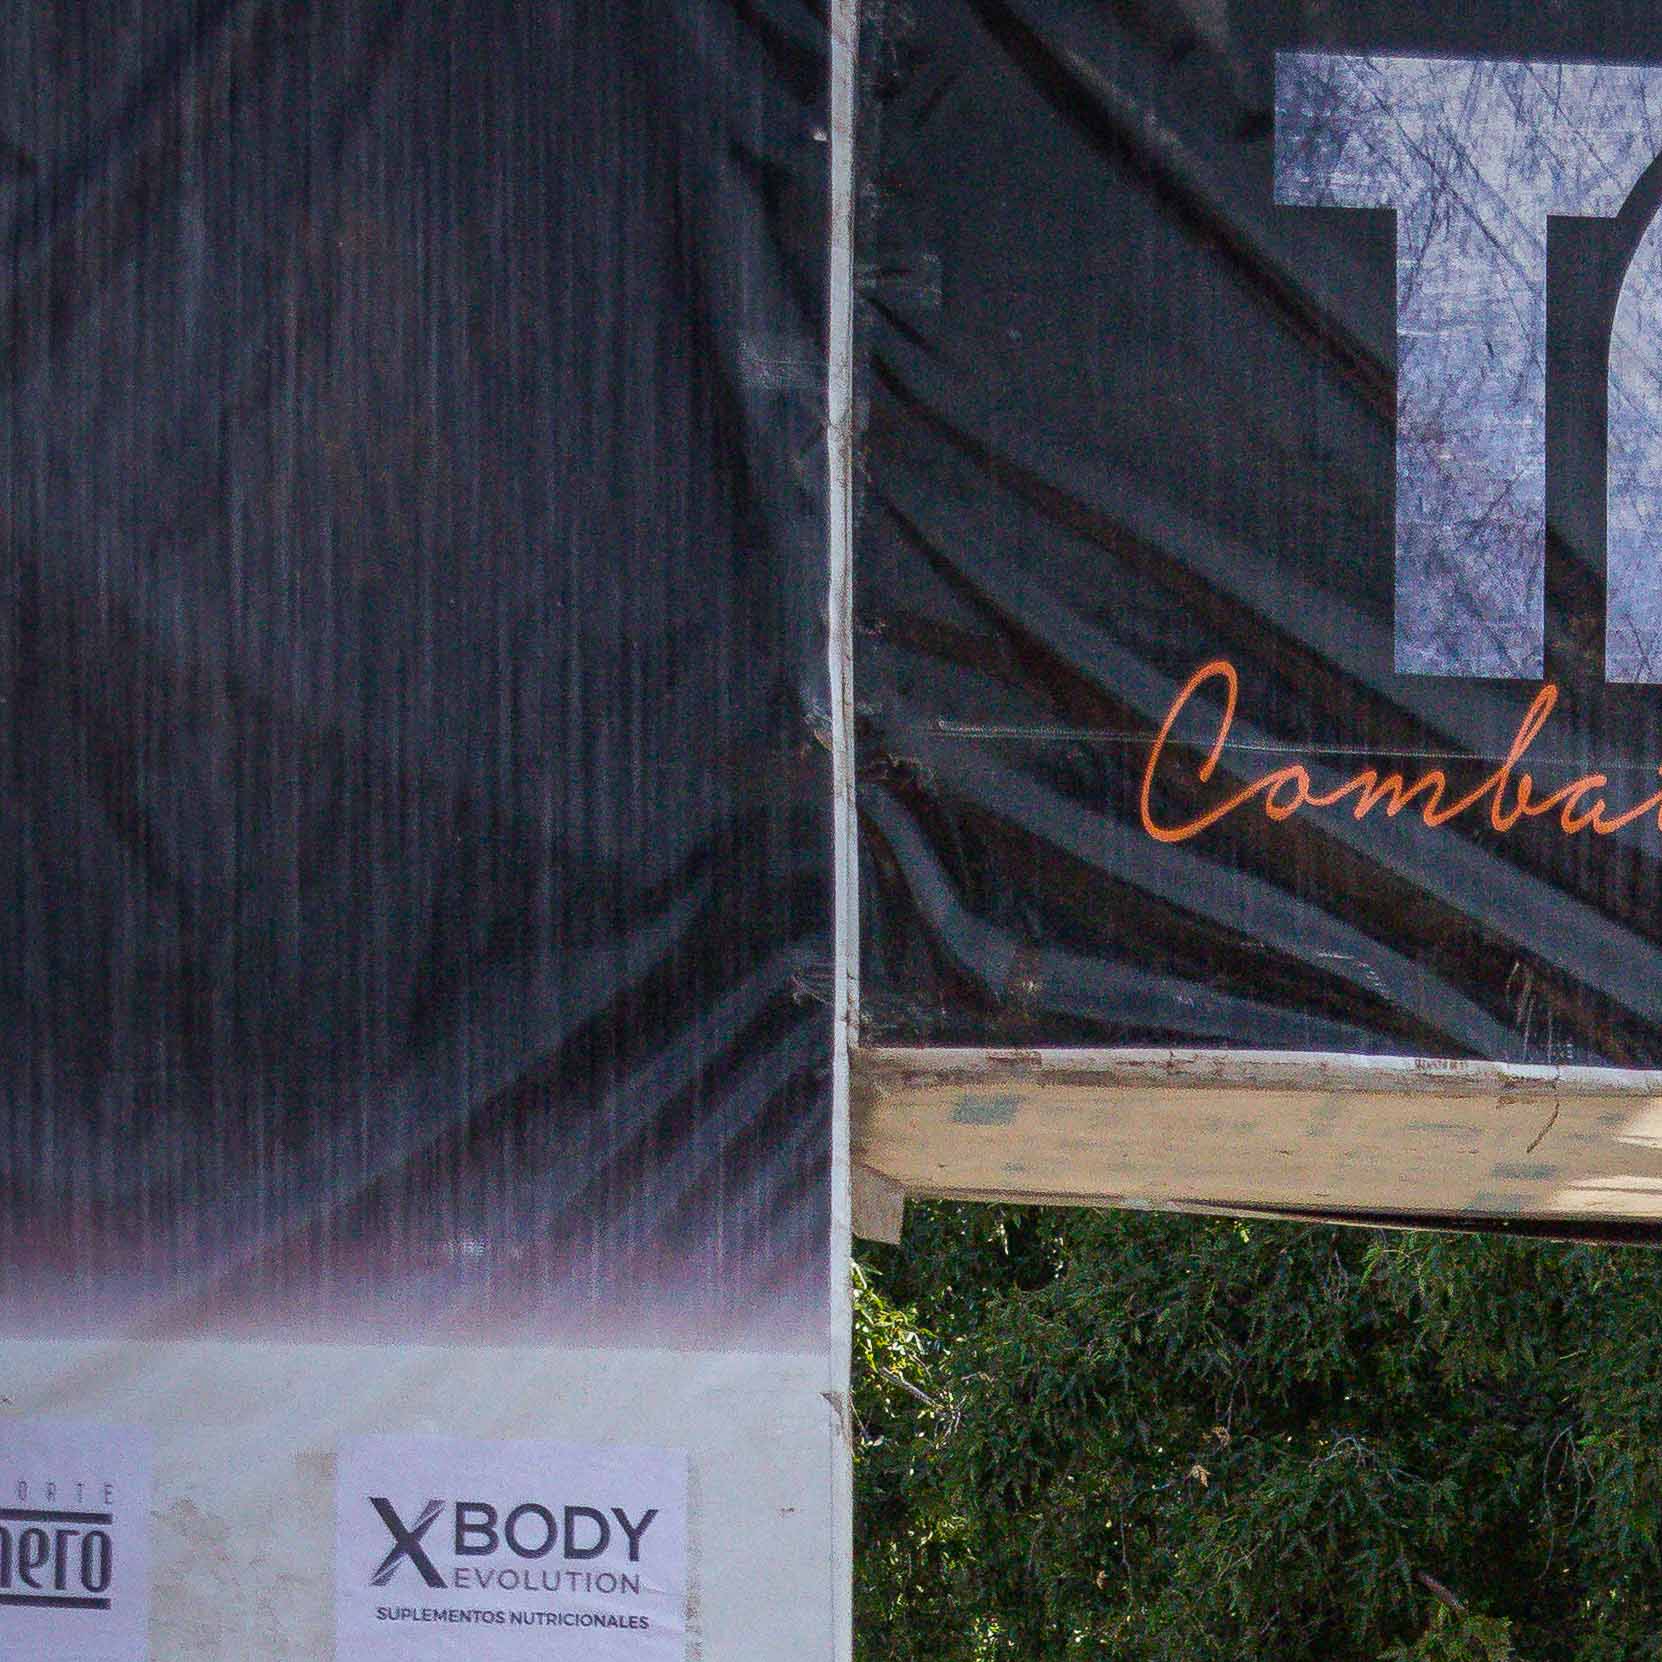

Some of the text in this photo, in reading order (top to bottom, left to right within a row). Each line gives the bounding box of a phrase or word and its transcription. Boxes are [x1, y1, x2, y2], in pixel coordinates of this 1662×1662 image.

[454, 1568, 640, 1594] EVOLUTION
[376, 1606, 649, 1630] SUPLEMENTOS NUTRICIONALES
